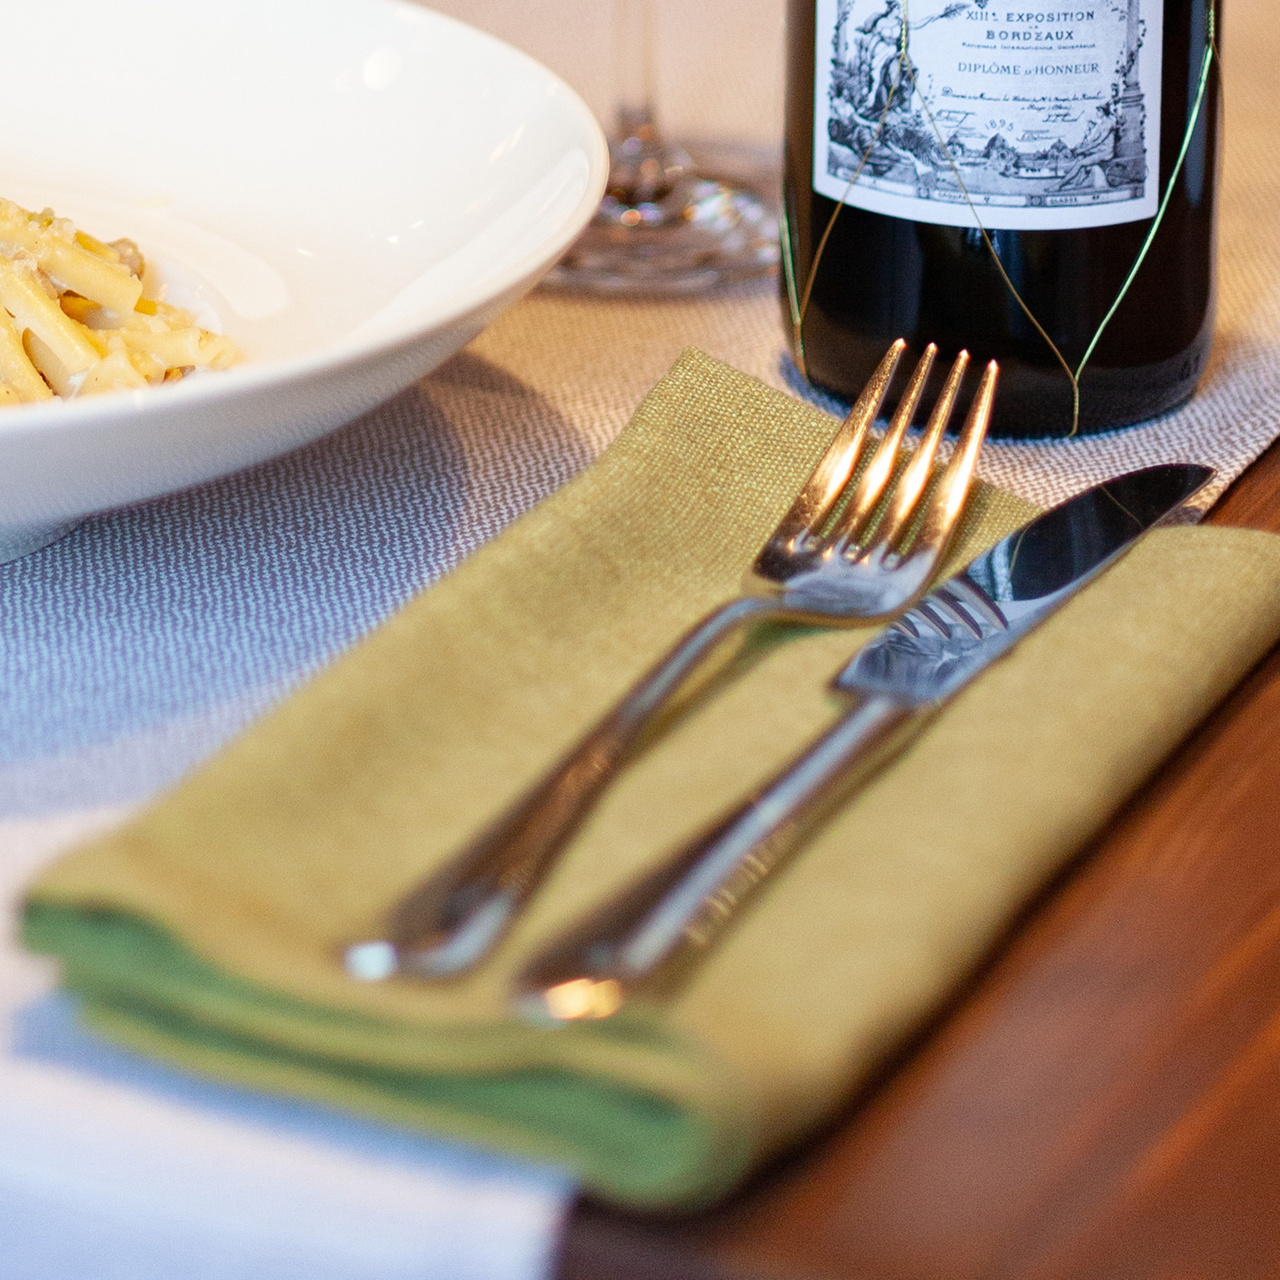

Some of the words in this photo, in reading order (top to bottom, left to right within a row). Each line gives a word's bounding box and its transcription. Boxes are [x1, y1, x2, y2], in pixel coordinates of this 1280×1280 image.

[1006, 11, 1095, 23] EXPOSITION
[986, 30, 1074, 41] BORDEAUX
[958, 61, 1020, 75] DIPLÔME
